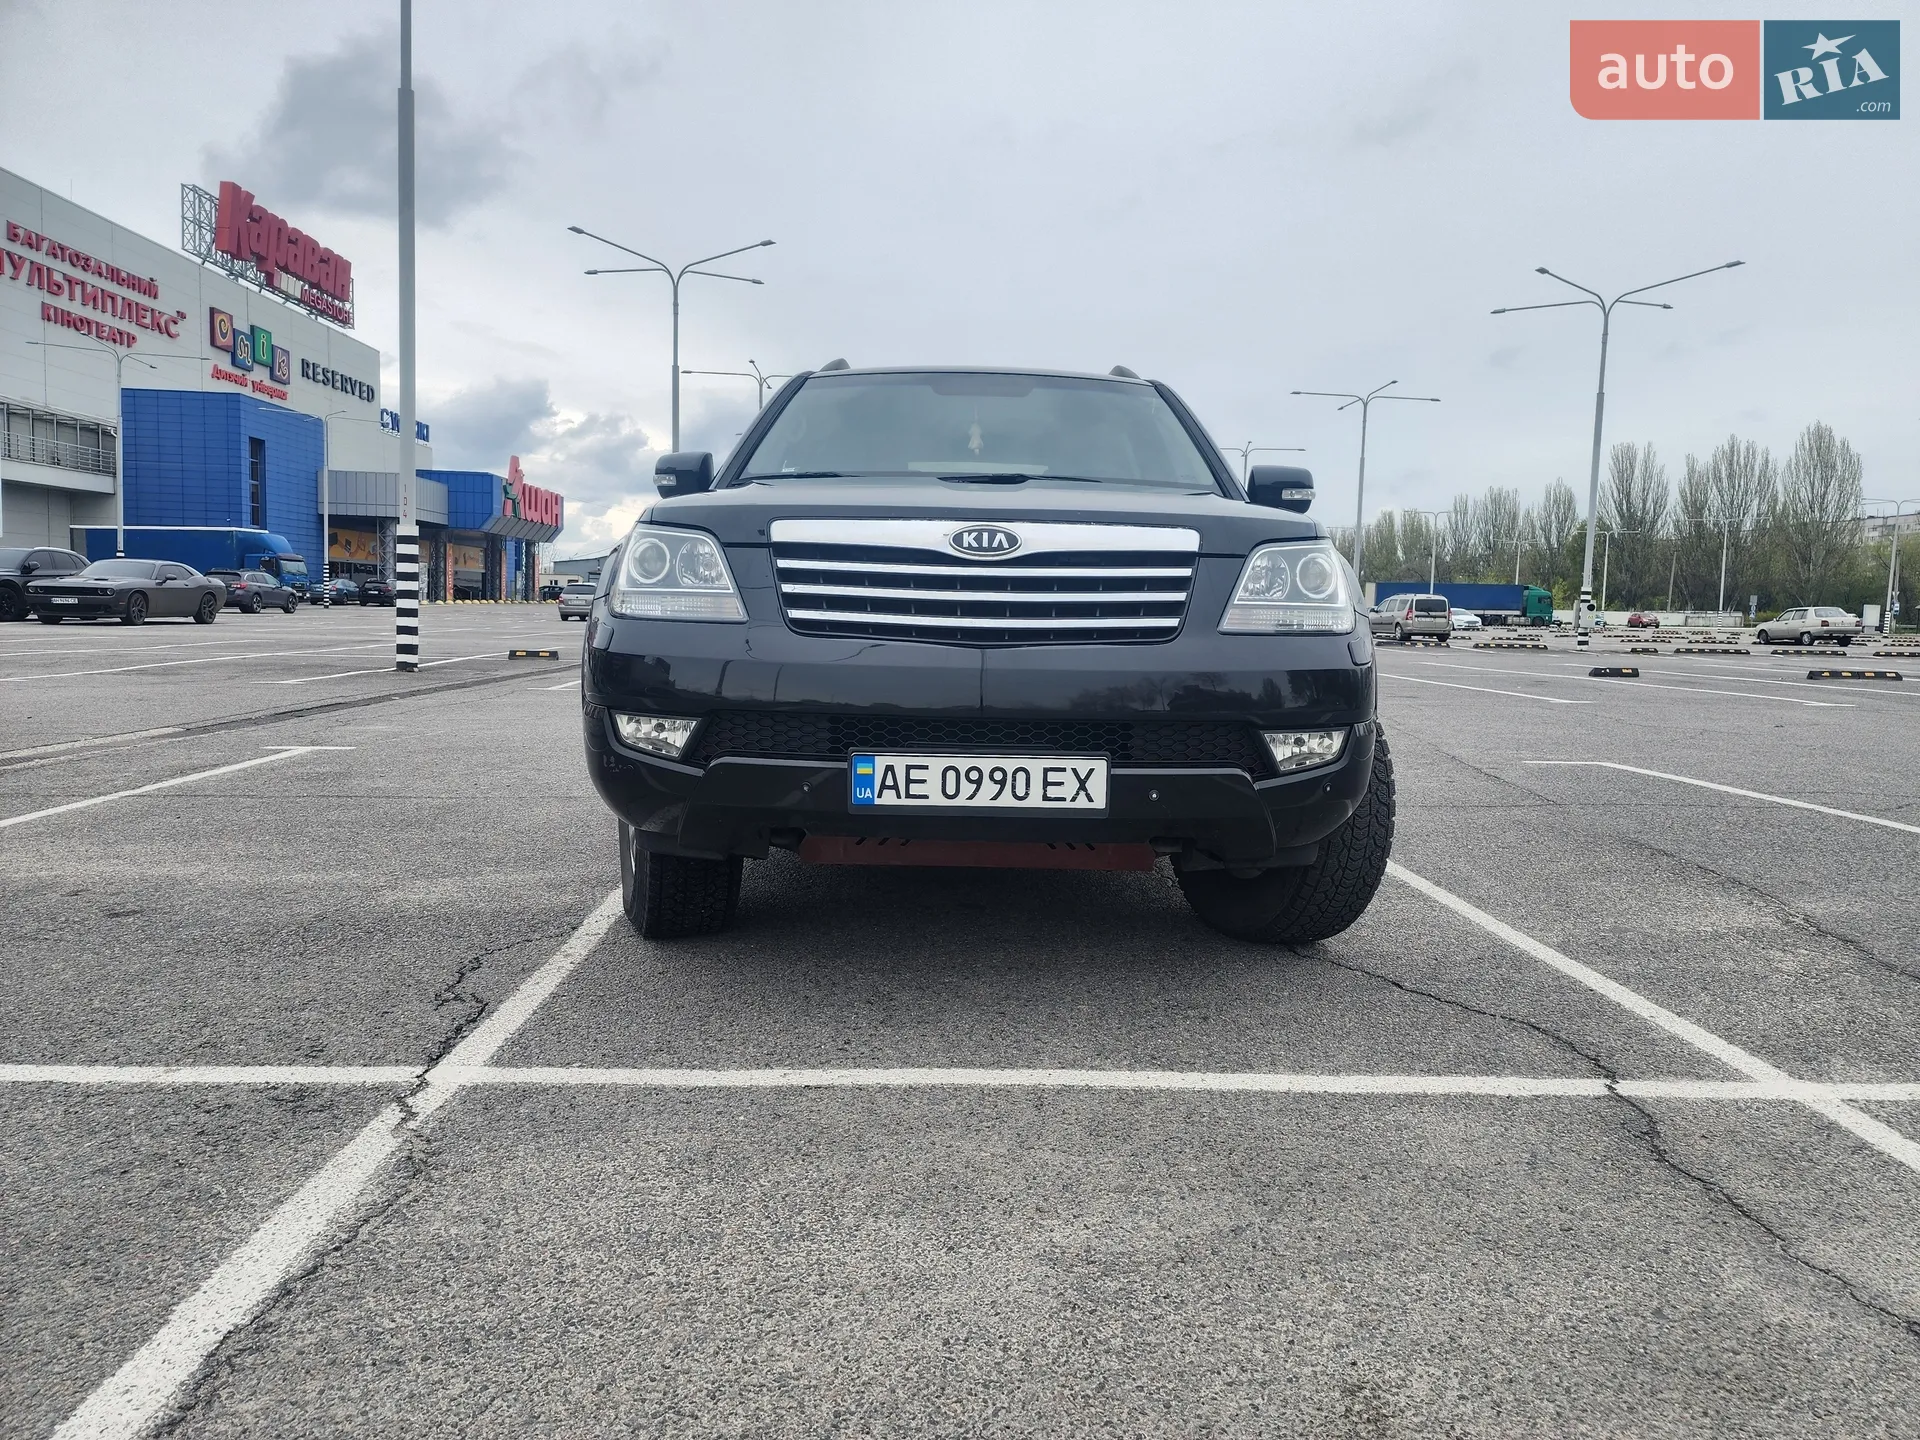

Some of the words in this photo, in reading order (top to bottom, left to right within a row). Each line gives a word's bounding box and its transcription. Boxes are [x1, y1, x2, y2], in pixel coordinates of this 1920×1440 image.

[7, 220, 159, 300] БАГАТОЗАЛЬНИЙ
[215, 181, 351, 303] Караван
[0, 248, 180, 339] УЛЬТИПЛЕКС
[41, 301, 138, 348] КІНОТЕАТР
[211, 364, 249, 387] Дитячий
[301, 358, 375, 402] RESERVED
[962, 531, 1010, 549] KIA
[856, 787, 873, 799] UA
[876, 764, 930, 800] AE
[941, 765, 1031, 801] 0990
[1041, 767, 1096, 803] EX
